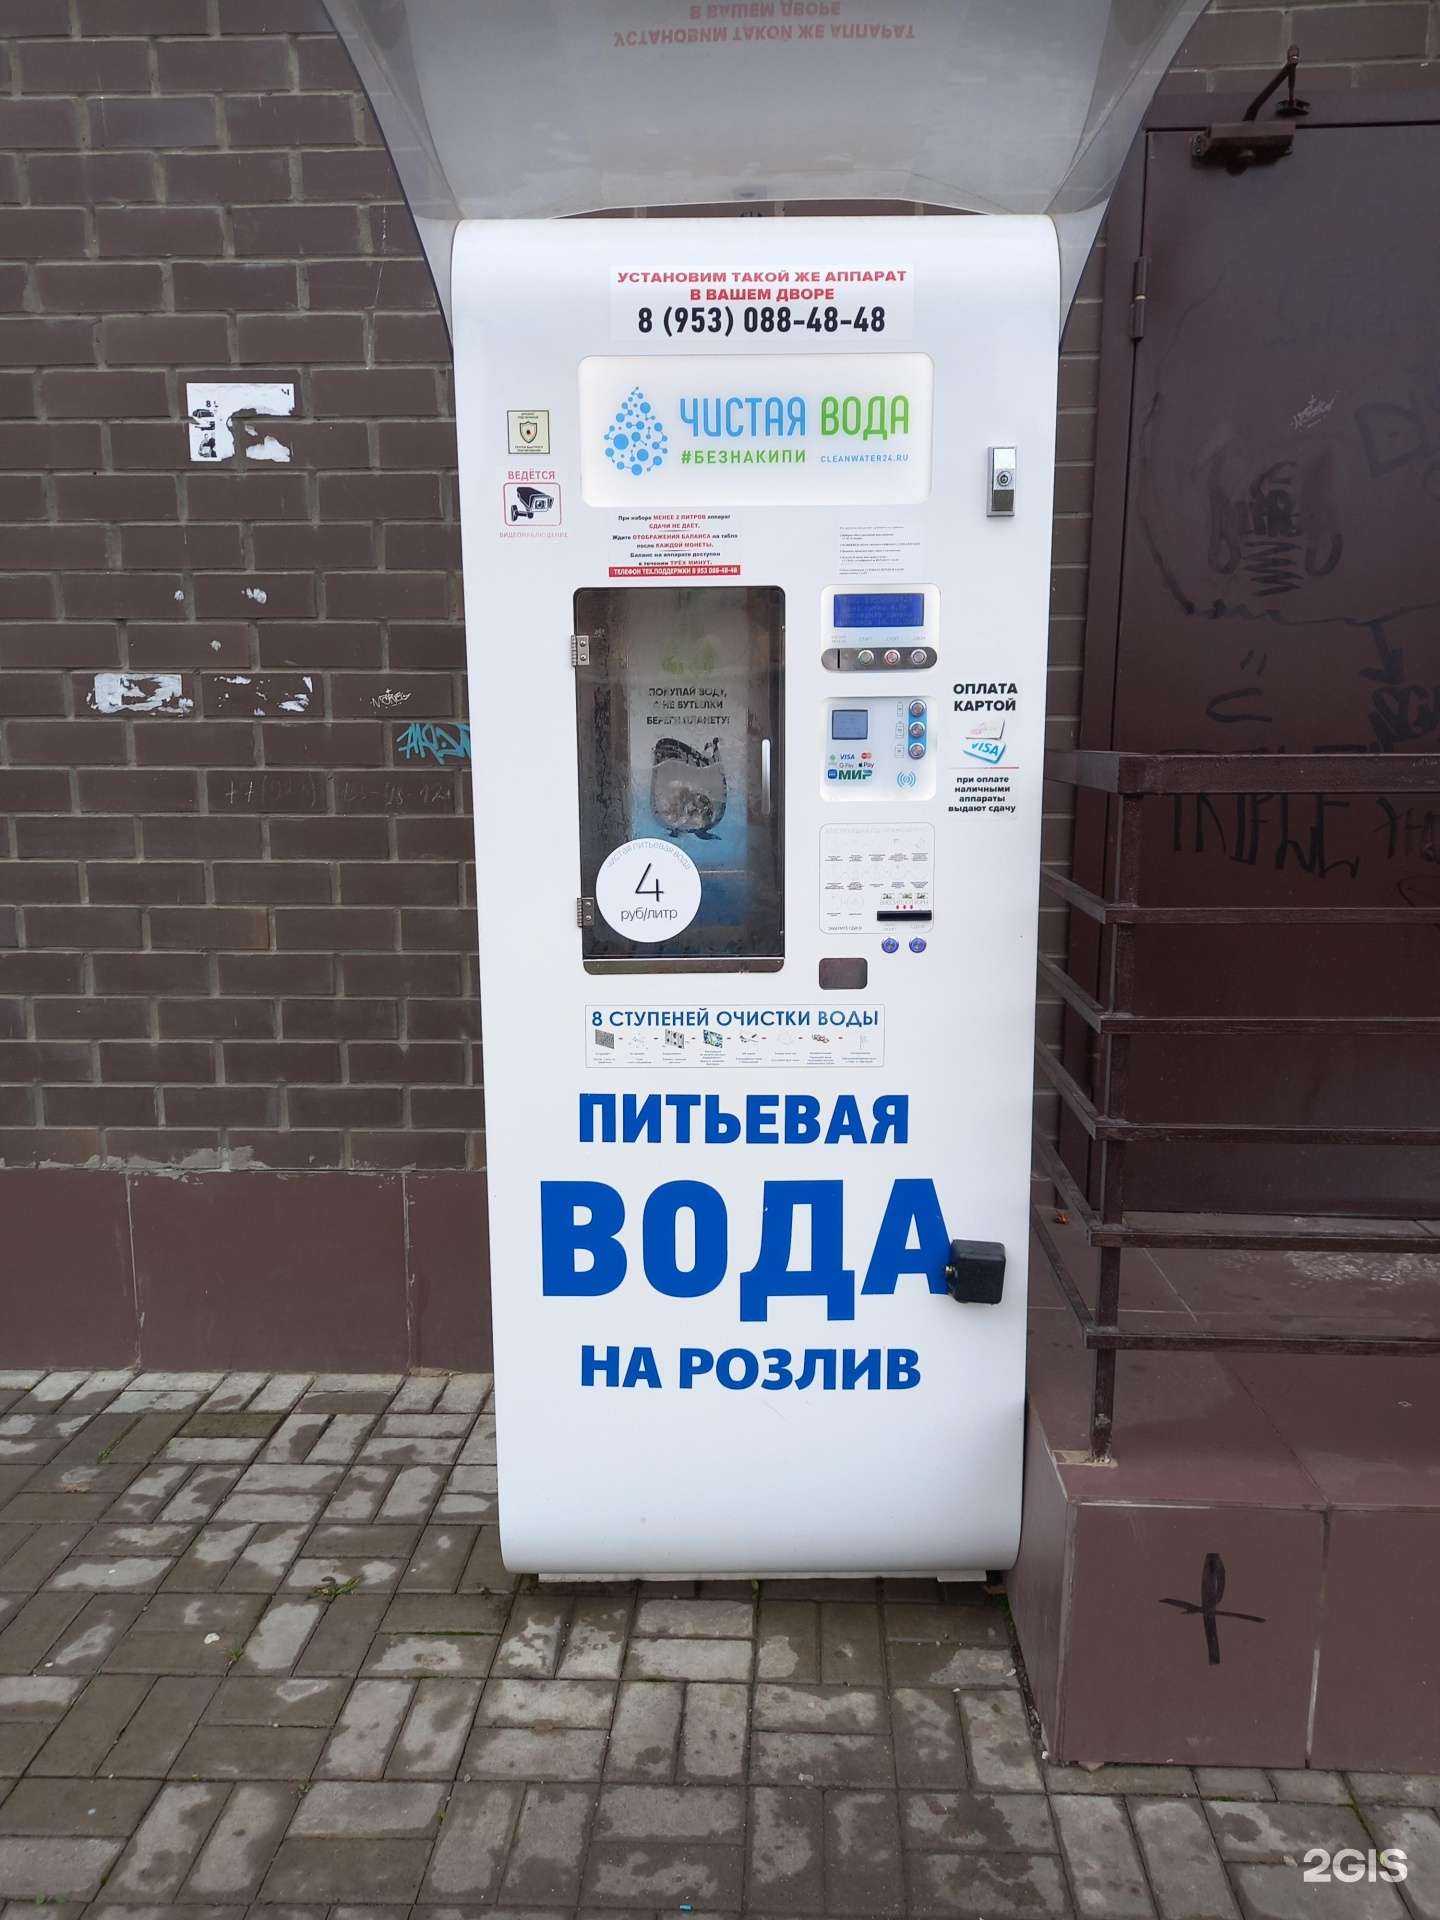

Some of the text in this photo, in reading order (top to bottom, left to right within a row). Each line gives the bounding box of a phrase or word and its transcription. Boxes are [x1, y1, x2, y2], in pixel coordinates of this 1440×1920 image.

[617, 269, 907, 284] УСТАНОВИМ ТАКОЙ ЖЕ АППАРАТ
[690, 288, 835, 302] В ВАШЕМ ДВОРЕ
[638, 306, 886, 337] 8 (953) 088-48-48
[679, 395, 910, 441] ЧИСТАЯ ВОДА
[681, 449, 807, 464] #БЕЗНАКИПИ
[820, 453, 909, 464] CLEANWATER24.RU
[507, 468, 556, 482] ВЕДЁТСЯ
[953, 683, 1018, 695] ОПЛАТА
[953, 698, 1017, 712] КАРТОЙ
[838, 769, 873, 780] МИР
[956, 776, 1010, 785] при оплате
[954, 785, 1011, 793] наличными
[958, 795, 1006, 803] аппараты
[947, 804, 1016, 813] выдают сдачу
[635, 862, 665, 902] 4
[620, 906, 678, 922] руб/литр
[591, 1007, 879, 1028] 8 СТУПЕНЕЙ ОЧИСТКИ ВОДЫ
[578, 1092, 910, 1145] ПИТЬЕВАЯ
[540, 1178, 953, 1322] ВОДА
[581, 1345, 922, 1391] НА РОЗЛИВ
